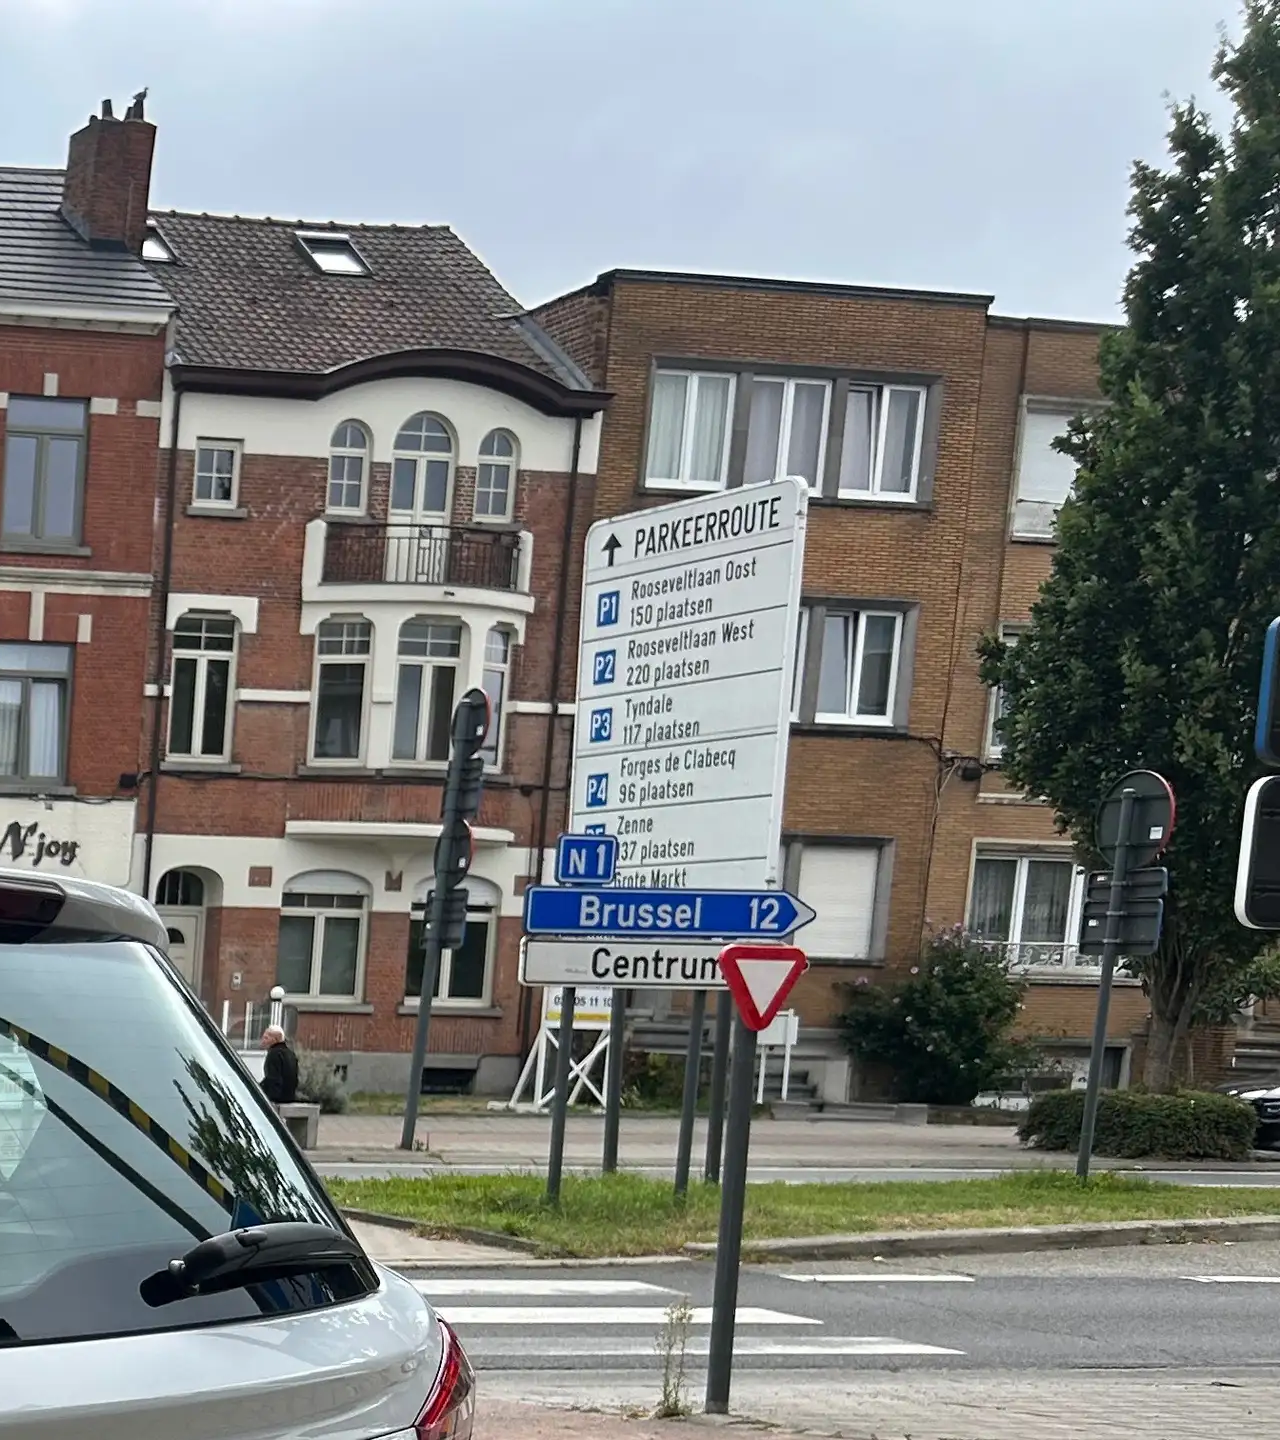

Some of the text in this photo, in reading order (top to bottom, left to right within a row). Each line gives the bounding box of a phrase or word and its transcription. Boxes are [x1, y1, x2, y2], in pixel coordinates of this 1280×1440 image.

[634, 496, 782, 558] PARKEERROUTE
[631, 557, 757, 601] Rooseveltlaan Oost
[600, 595, 617, 622] P1
[631, 597, 712, 629] 150 plaatsen
[627, 619, 755, 660] Rooseveltlaan West
[595, 655, 614, 682] P2
[626, 658, 710, 689] 220 plaatsen
[625, 694, 673, 723] Tyndale
[592, 712, 611, 741] P3
[623, 719, 700, 749] 117 plaatsen
[620, 748, 736, 780] Forges de Clabecq
[587, 778, 607, 804] P4
[619, 780, 694, 807] 96 plaatsen
[616, 815, 653, 836] Zenne
[568, 844, 607, 876] N 1
[640, 837, 694, 866] plaatsen
[651, 868, 687, 888] Markt
[579, 894, 779, 930] Brussel 12
[592, 947, 722, 980] Centrum
